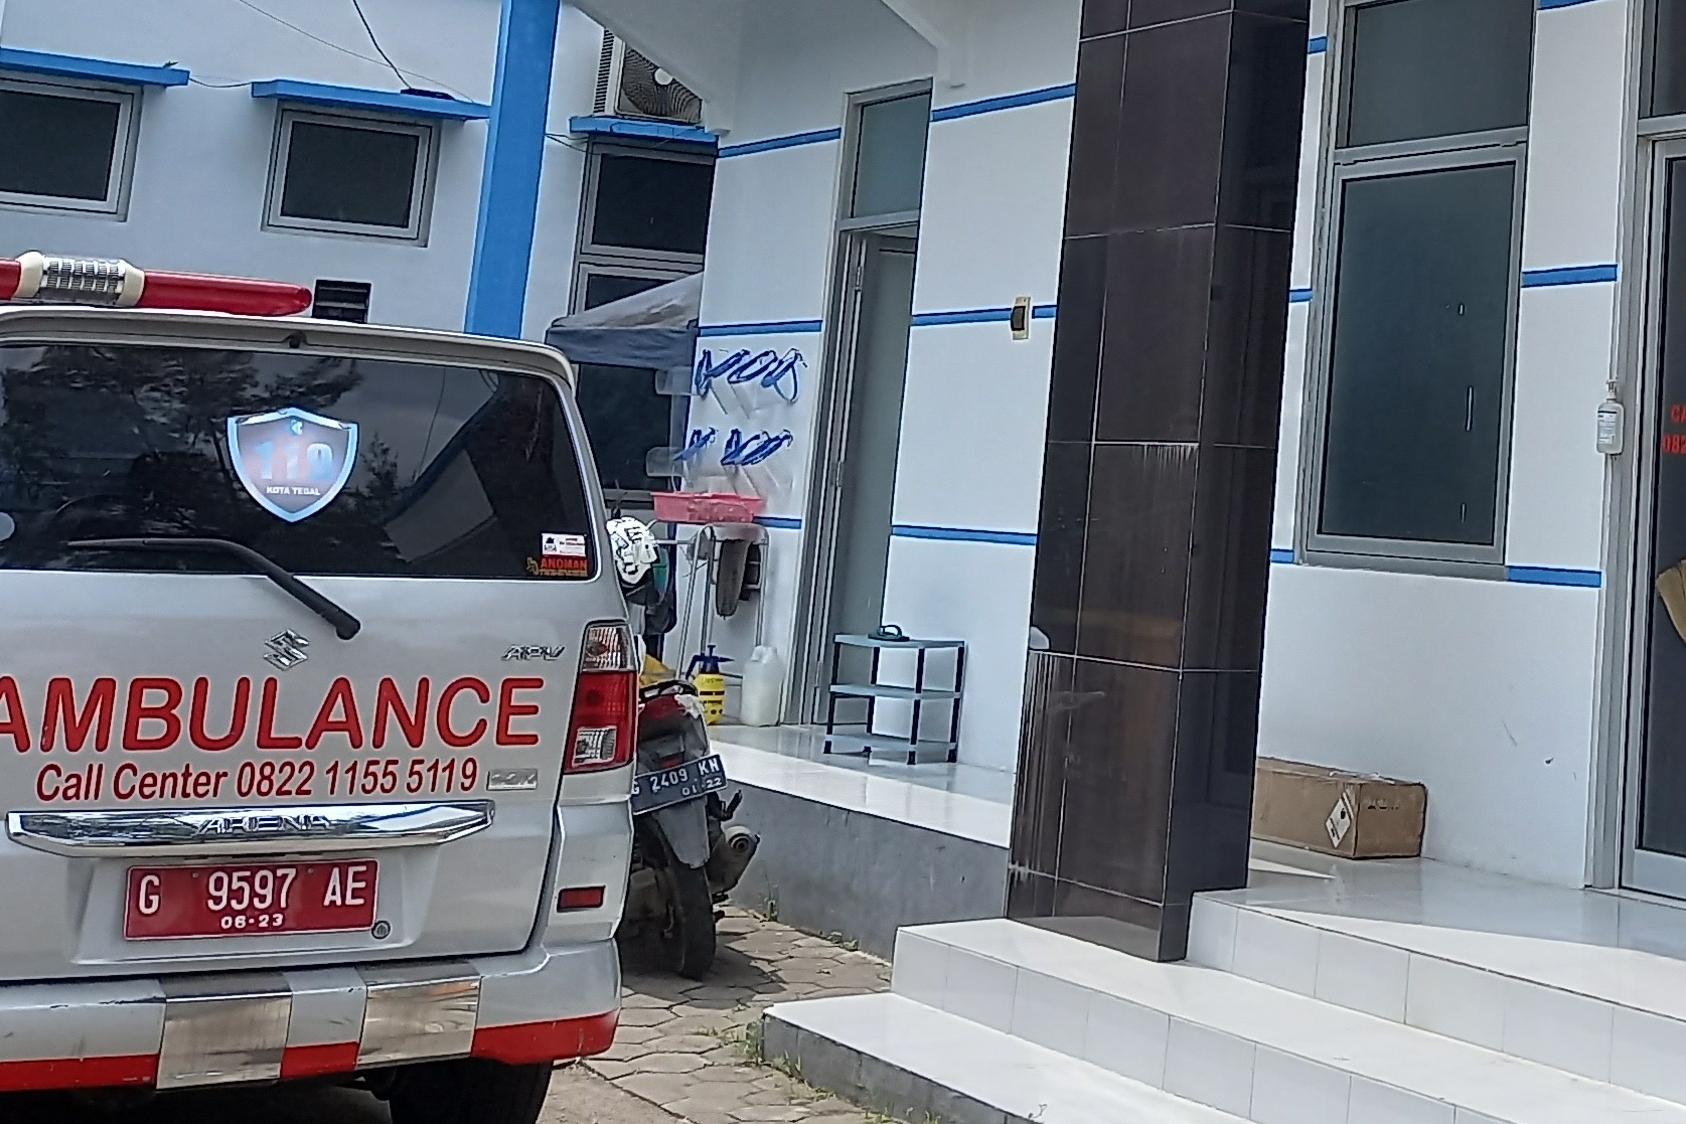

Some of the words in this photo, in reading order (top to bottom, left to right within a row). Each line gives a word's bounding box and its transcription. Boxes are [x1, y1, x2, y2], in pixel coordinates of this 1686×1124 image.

[254, 440, 333, 481] 119
[266, 486, 291, 495] KOTA
[291, 486, 321, 496] TEGAL
[501, 644, 565, 661] APV
[0, 675, 545, 753] AMBULANCE
[36, 763, 104, 801] Call
[112, 762, 229, 800] Center
[236, 760, 315, 798] 0822
[325, 758, 400, 796] 1155
[406, 757, 478, 794] 5119
[649, 768, 689, 793] 2409
[196, 813, 336, 835] ARENA
[138, 874, 160, 915] G
[207, 867, 298, 912] 9597
[322, 864, 367, 907] AE
